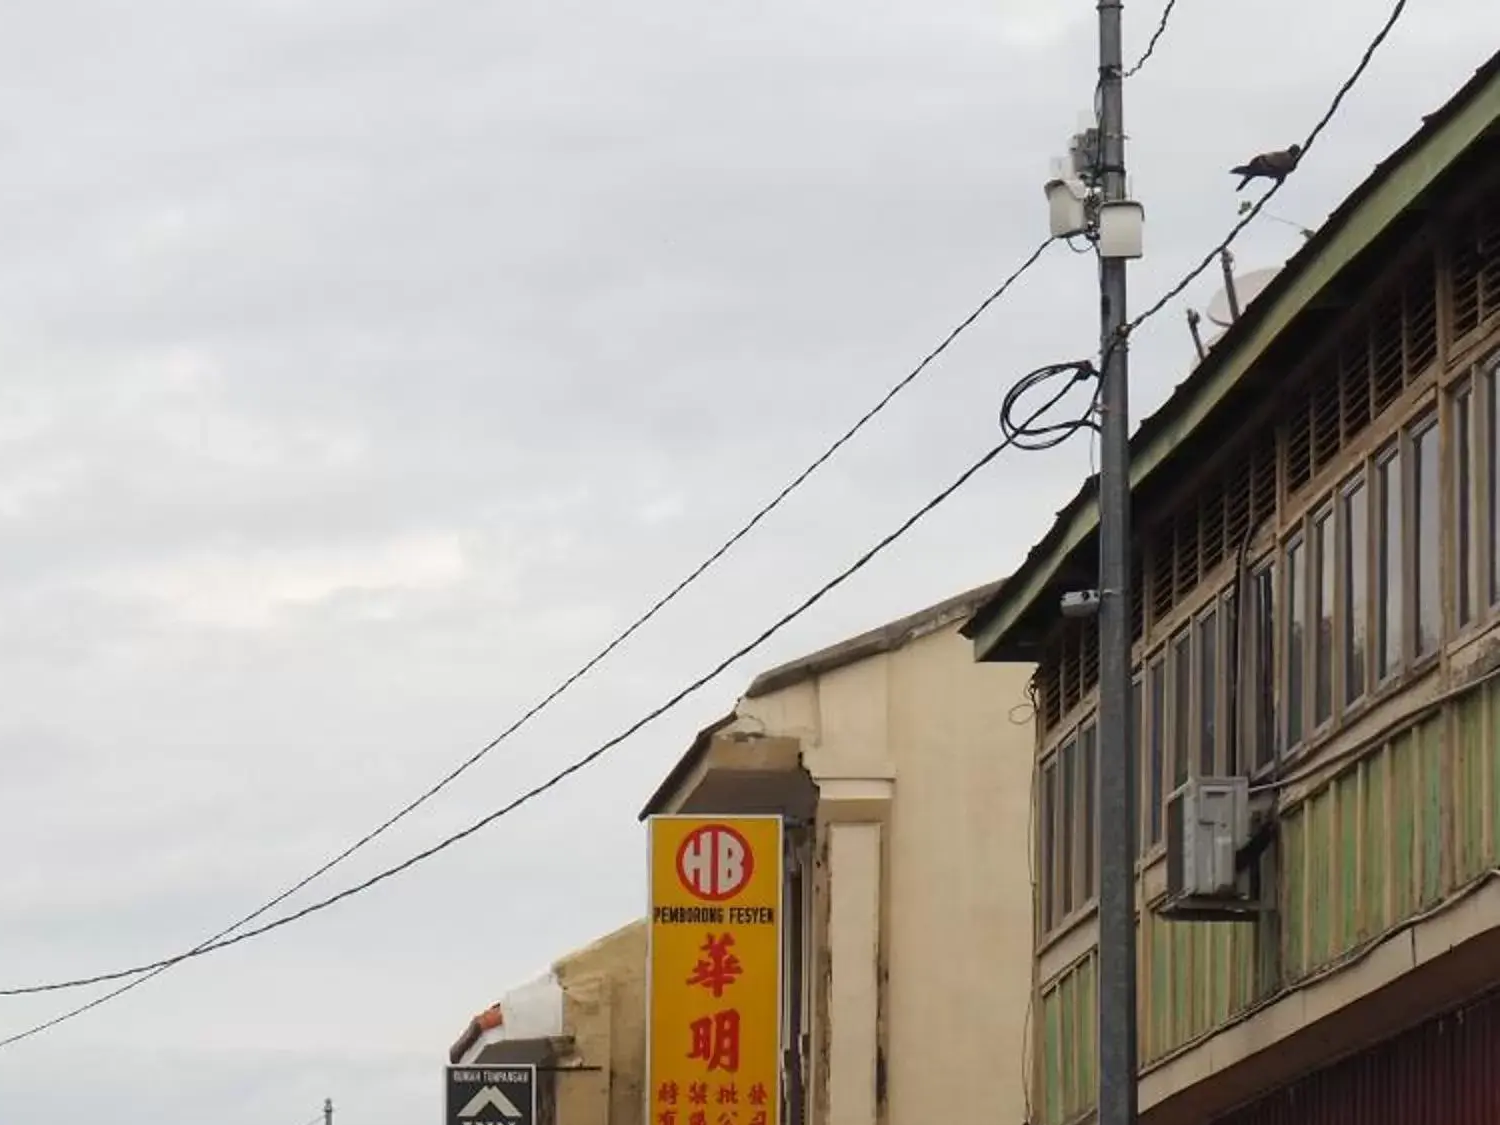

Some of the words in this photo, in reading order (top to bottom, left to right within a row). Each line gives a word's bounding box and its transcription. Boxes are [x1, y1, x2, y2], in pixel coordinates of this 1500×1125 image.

[653, 907, 724, 925] PEMBORONG
[729, 907, 775, 925] FESYEN
[686, 932, 744, 1072] 華明
